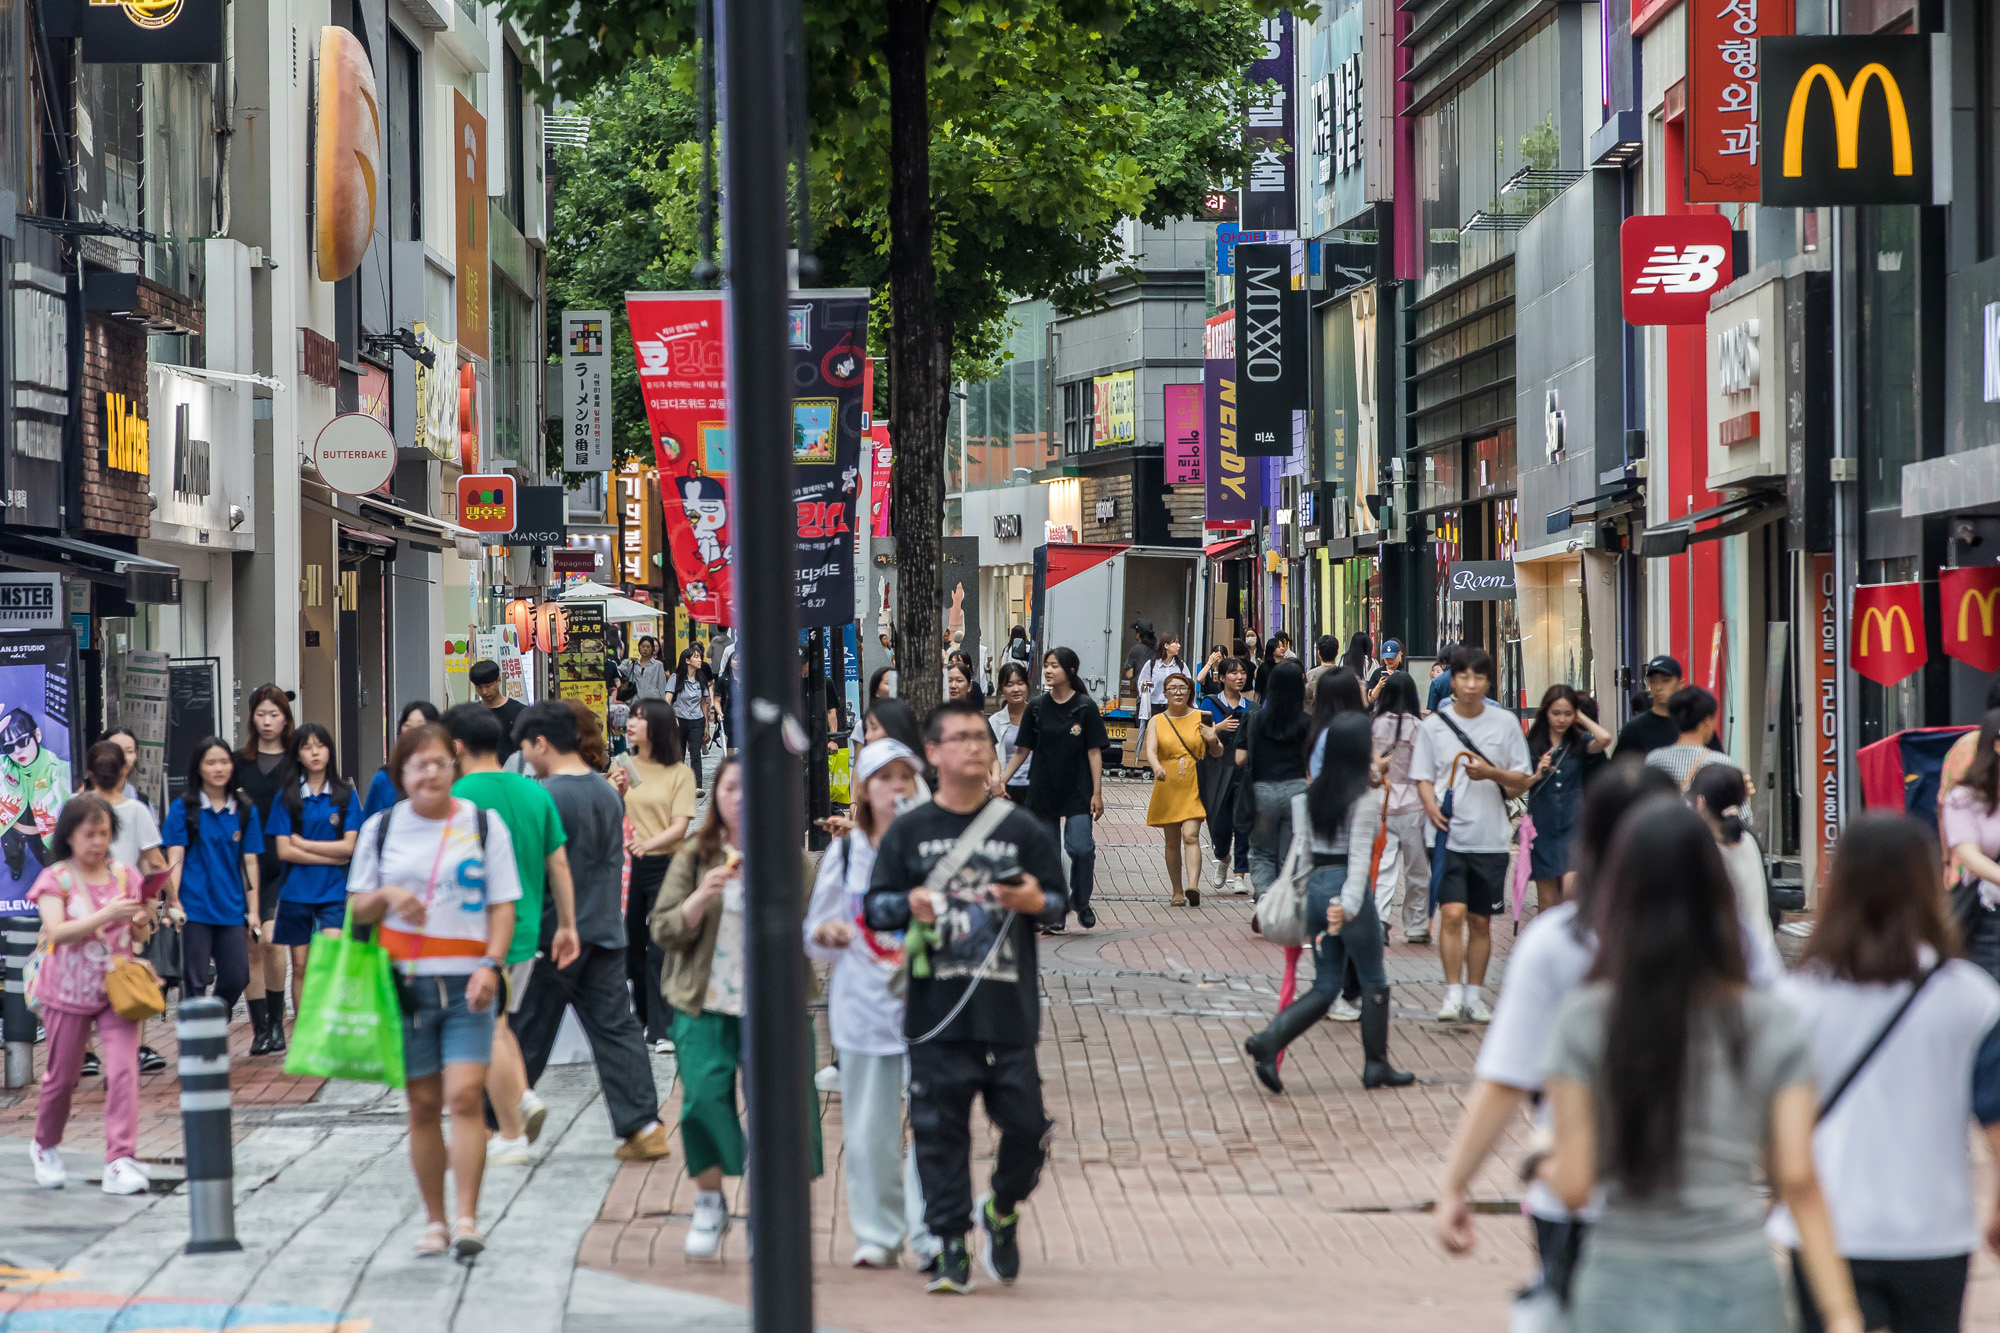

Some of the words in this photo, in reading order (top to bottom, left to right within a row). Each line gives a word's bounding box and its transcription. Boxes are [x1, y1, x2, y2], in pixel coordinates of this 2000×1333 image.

[1717, 0, 1760, 166] 성형외과
[1246, 264, 1281, 383] MIXXO
[574, 362, 589, 465] ラーメン81番屋
[1255, 431, 1276, 443] 미쏘
[323, 450, 387, 459] BUTTERBAKE
[508, 532, 559, 541] MANGO
[554, 560, 592, 569] Papageno
[1453, 570, 1516, 591] Roem
[19, 644, 46, 652] STUDIO
